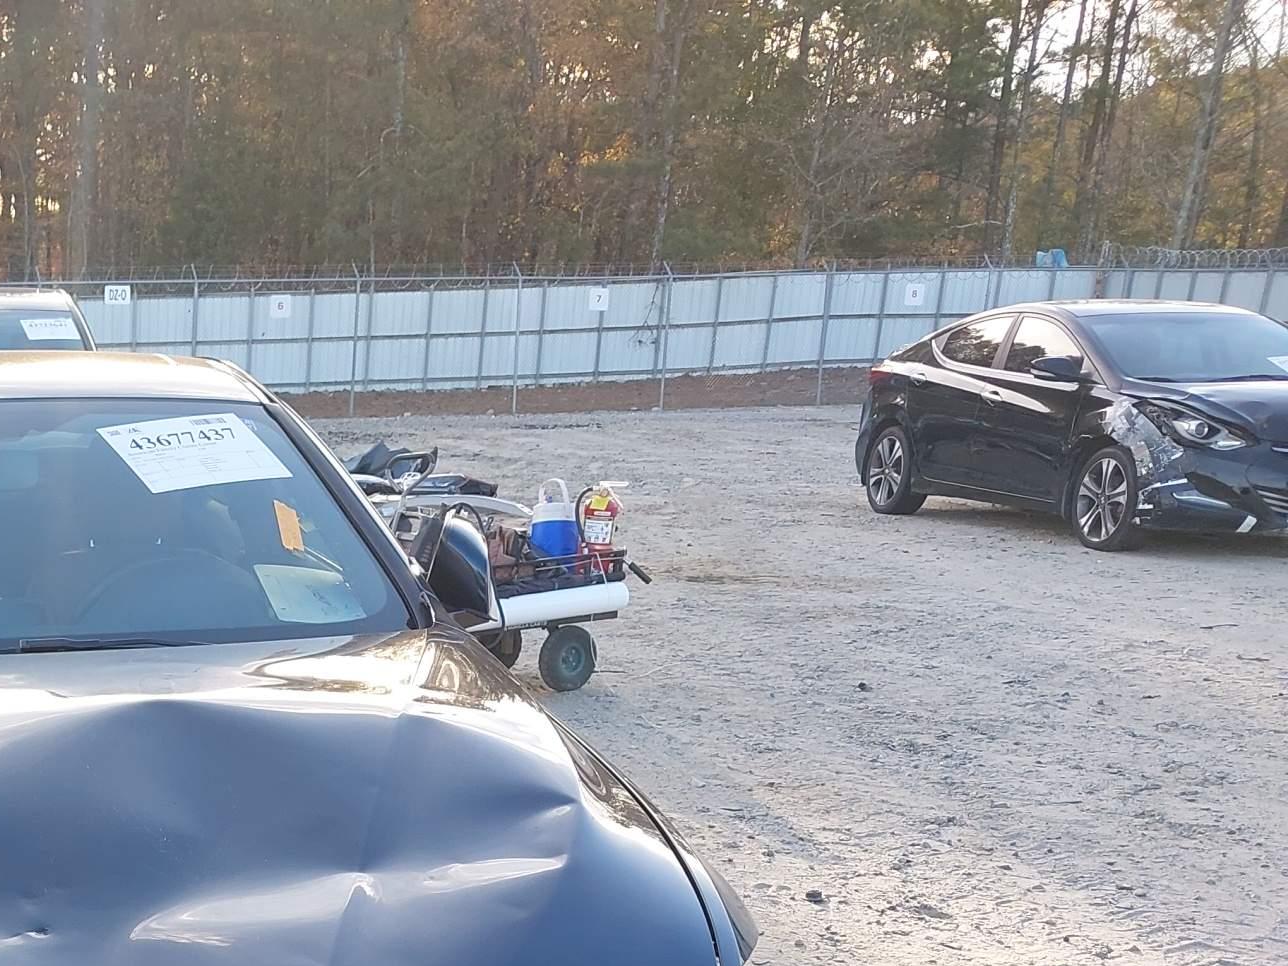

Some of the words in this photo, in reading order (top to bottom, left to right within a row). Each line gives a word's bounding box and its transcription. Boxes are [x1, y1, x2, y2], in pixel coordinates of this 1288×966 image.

[911, 289, 918, 298] 8
[596, 295, 602, 303] 7
[277, 301, 284, 310] 6
[129, 427, 236, 450] 43677437
